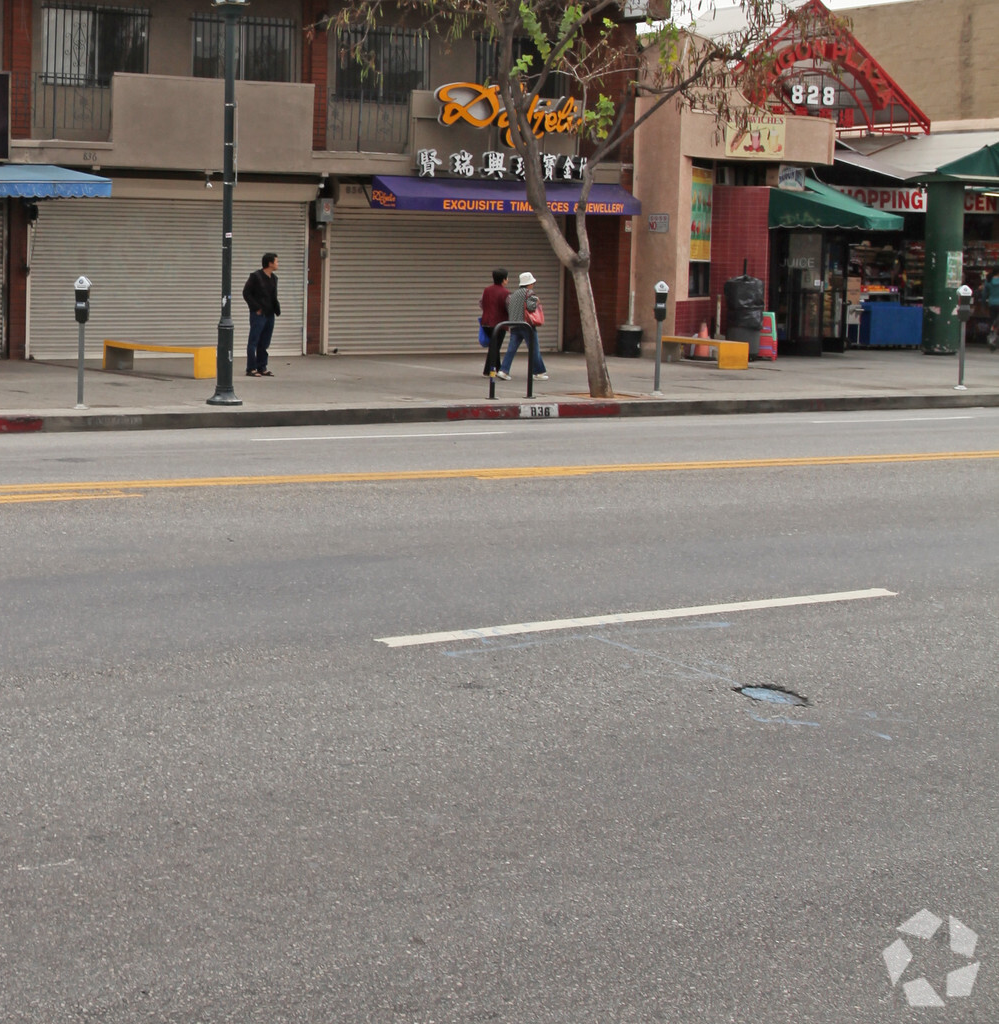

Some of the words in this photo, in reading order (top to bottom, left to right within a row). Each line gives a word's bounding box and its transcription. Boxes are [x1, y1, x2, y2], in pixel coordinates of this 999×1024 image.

[791, 85, 835, 106] 828
[442, 199, 504, 211] EXQUISITE
[510, 200, 569, 213] TIMEECES
[840, 188, 923, 210] OPPING
[778, 257, 815, 269] JUICE
